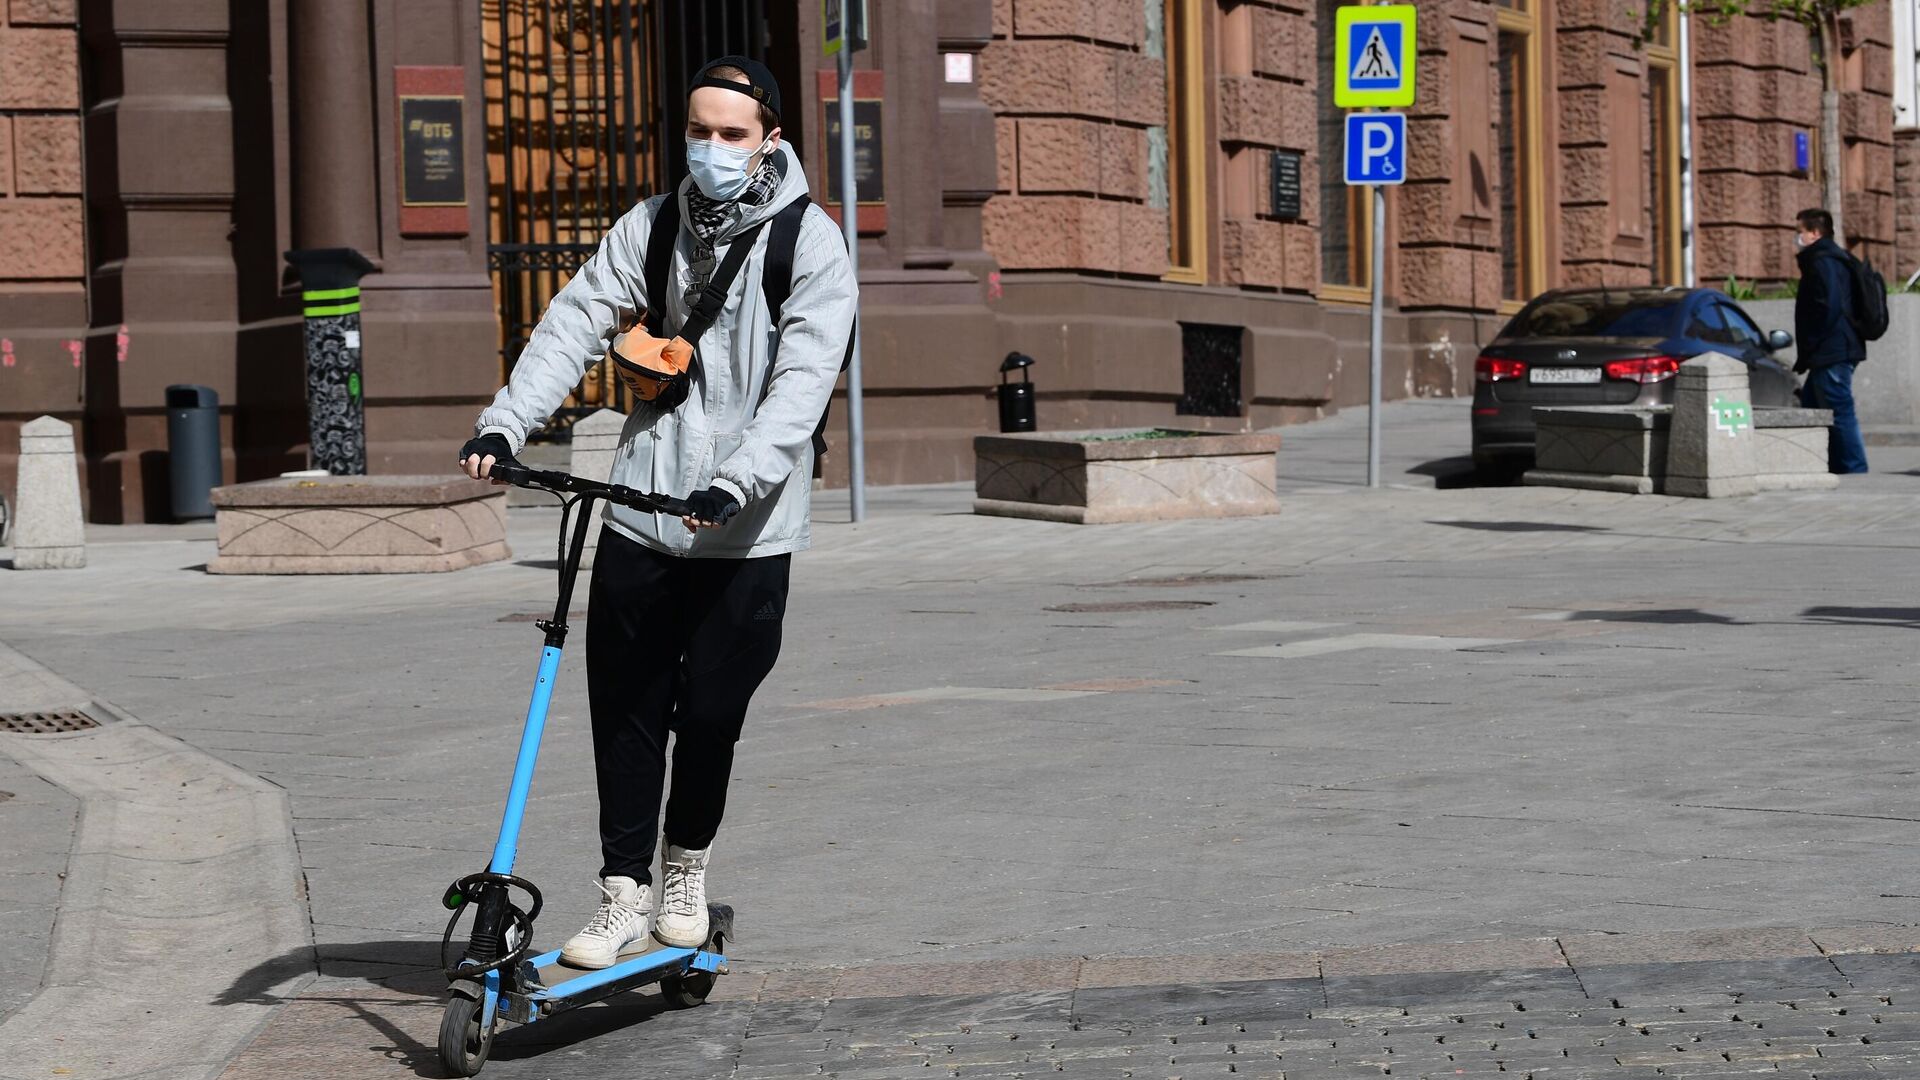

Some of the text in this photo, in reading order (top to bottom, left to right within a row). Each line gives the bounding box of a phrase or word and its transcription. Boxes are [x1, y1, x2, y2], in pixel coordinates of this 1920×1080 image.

[424, 122, 452, 138] ВТБ
[854, 124, 872, 139] ТБ
[1362, 122, 1394, 175] P
